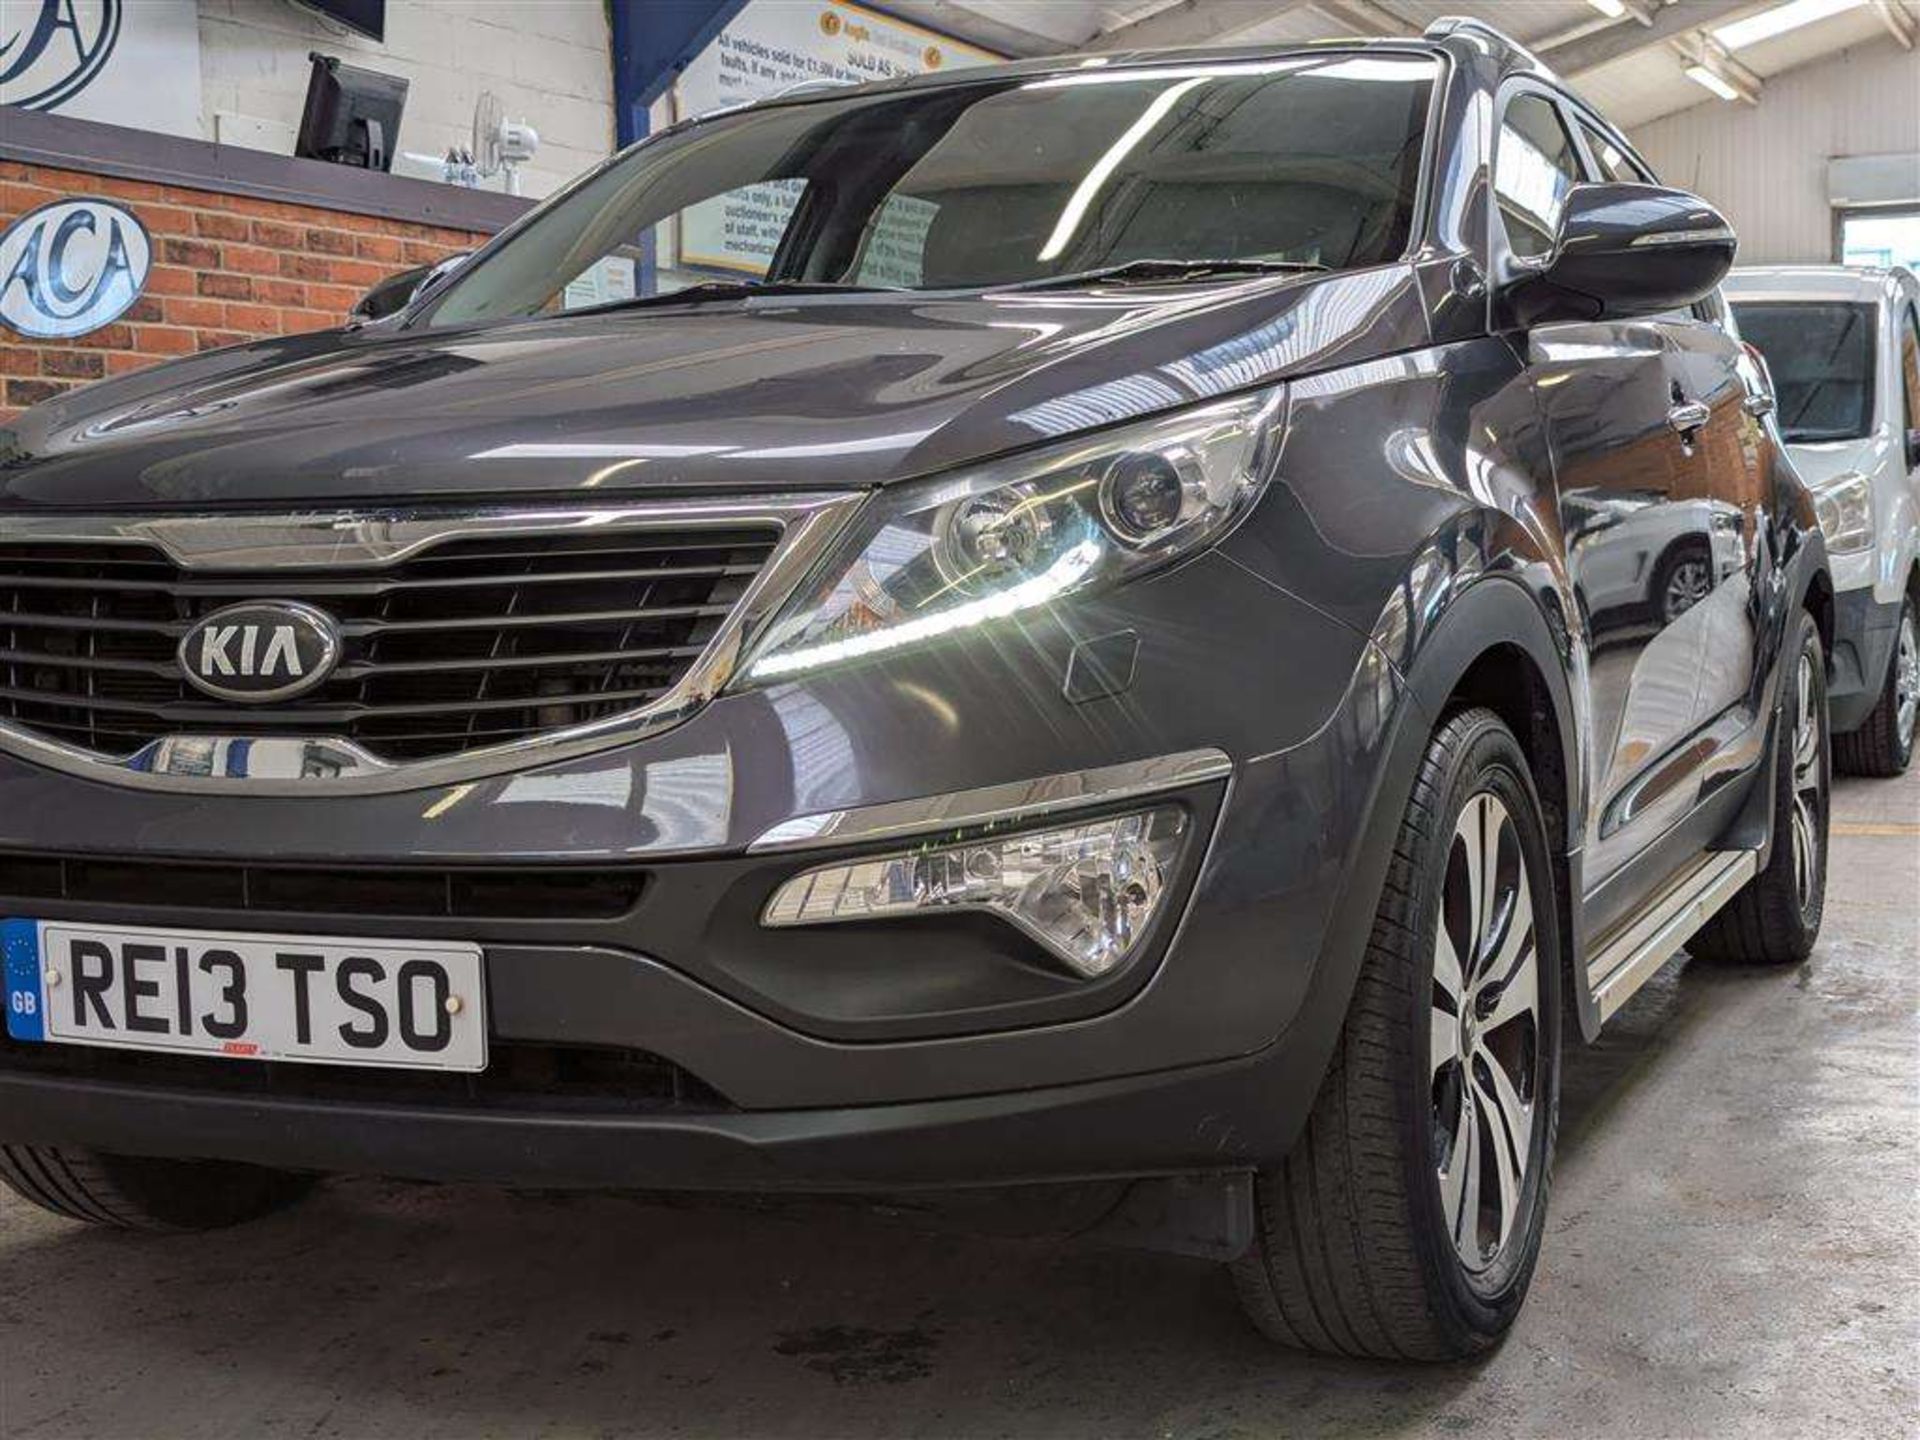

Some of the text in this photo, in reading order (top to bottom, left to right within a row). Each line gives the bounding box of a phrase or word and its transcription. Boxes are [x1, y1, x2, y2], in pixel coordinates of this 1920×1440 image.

[732, 38, 770, 60] vehicles
[772, 49, 791, 66] sold
[0, 209, 139, 319] ACA
[202, 625, 302, 676] KIA
[12, 991, 36, 1016] GB
[69, 938, 453, 1053] RE13 TSO
